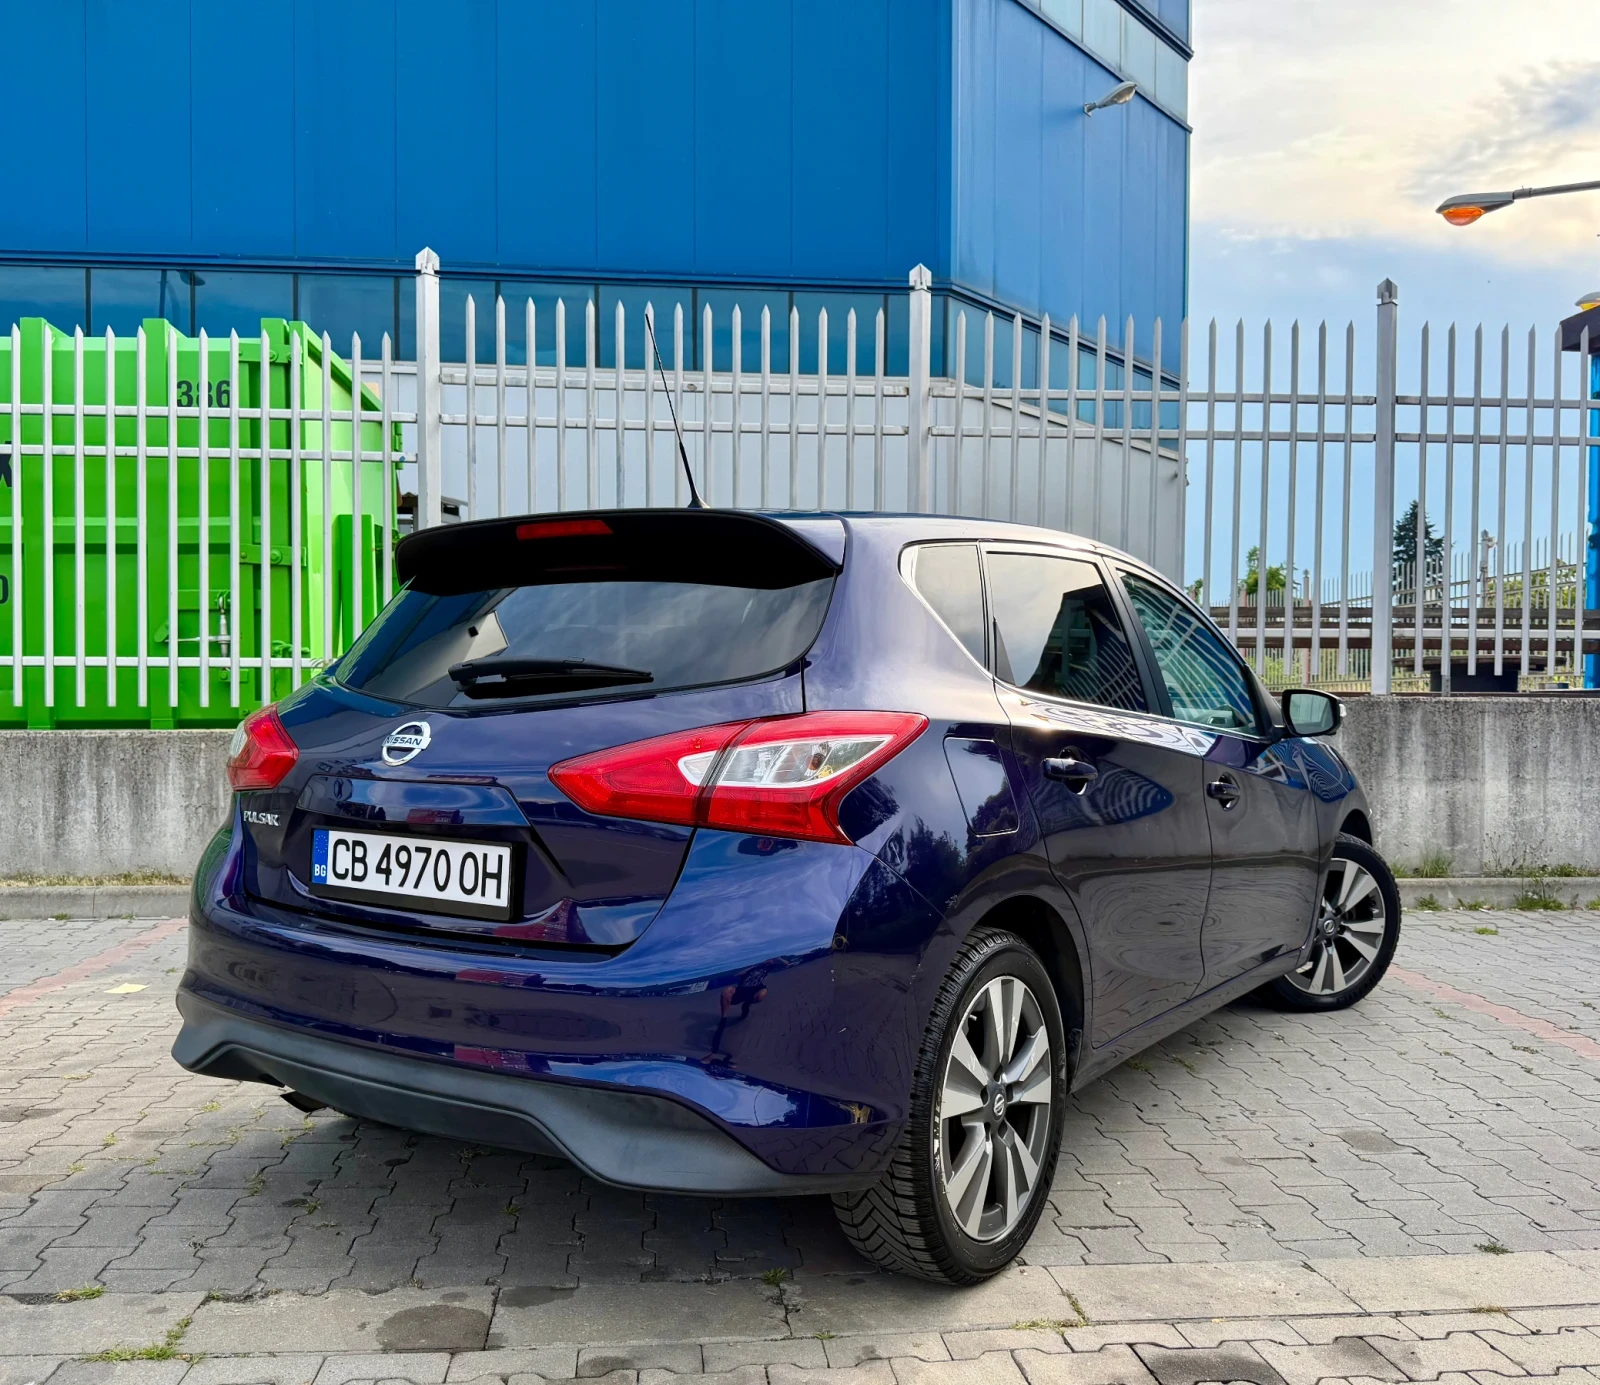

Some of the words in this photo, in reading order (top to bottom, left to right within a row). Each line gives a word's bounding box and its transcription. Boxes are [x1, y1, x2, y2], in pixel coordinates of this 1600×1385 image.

[383, 736, 422, 746] NISSAN
[314, 864, 327, 877] BG
[332, 838, 368, 883] CB
[375, 842, 451, 892] 4970
[459, 851, 503, 899] OH
